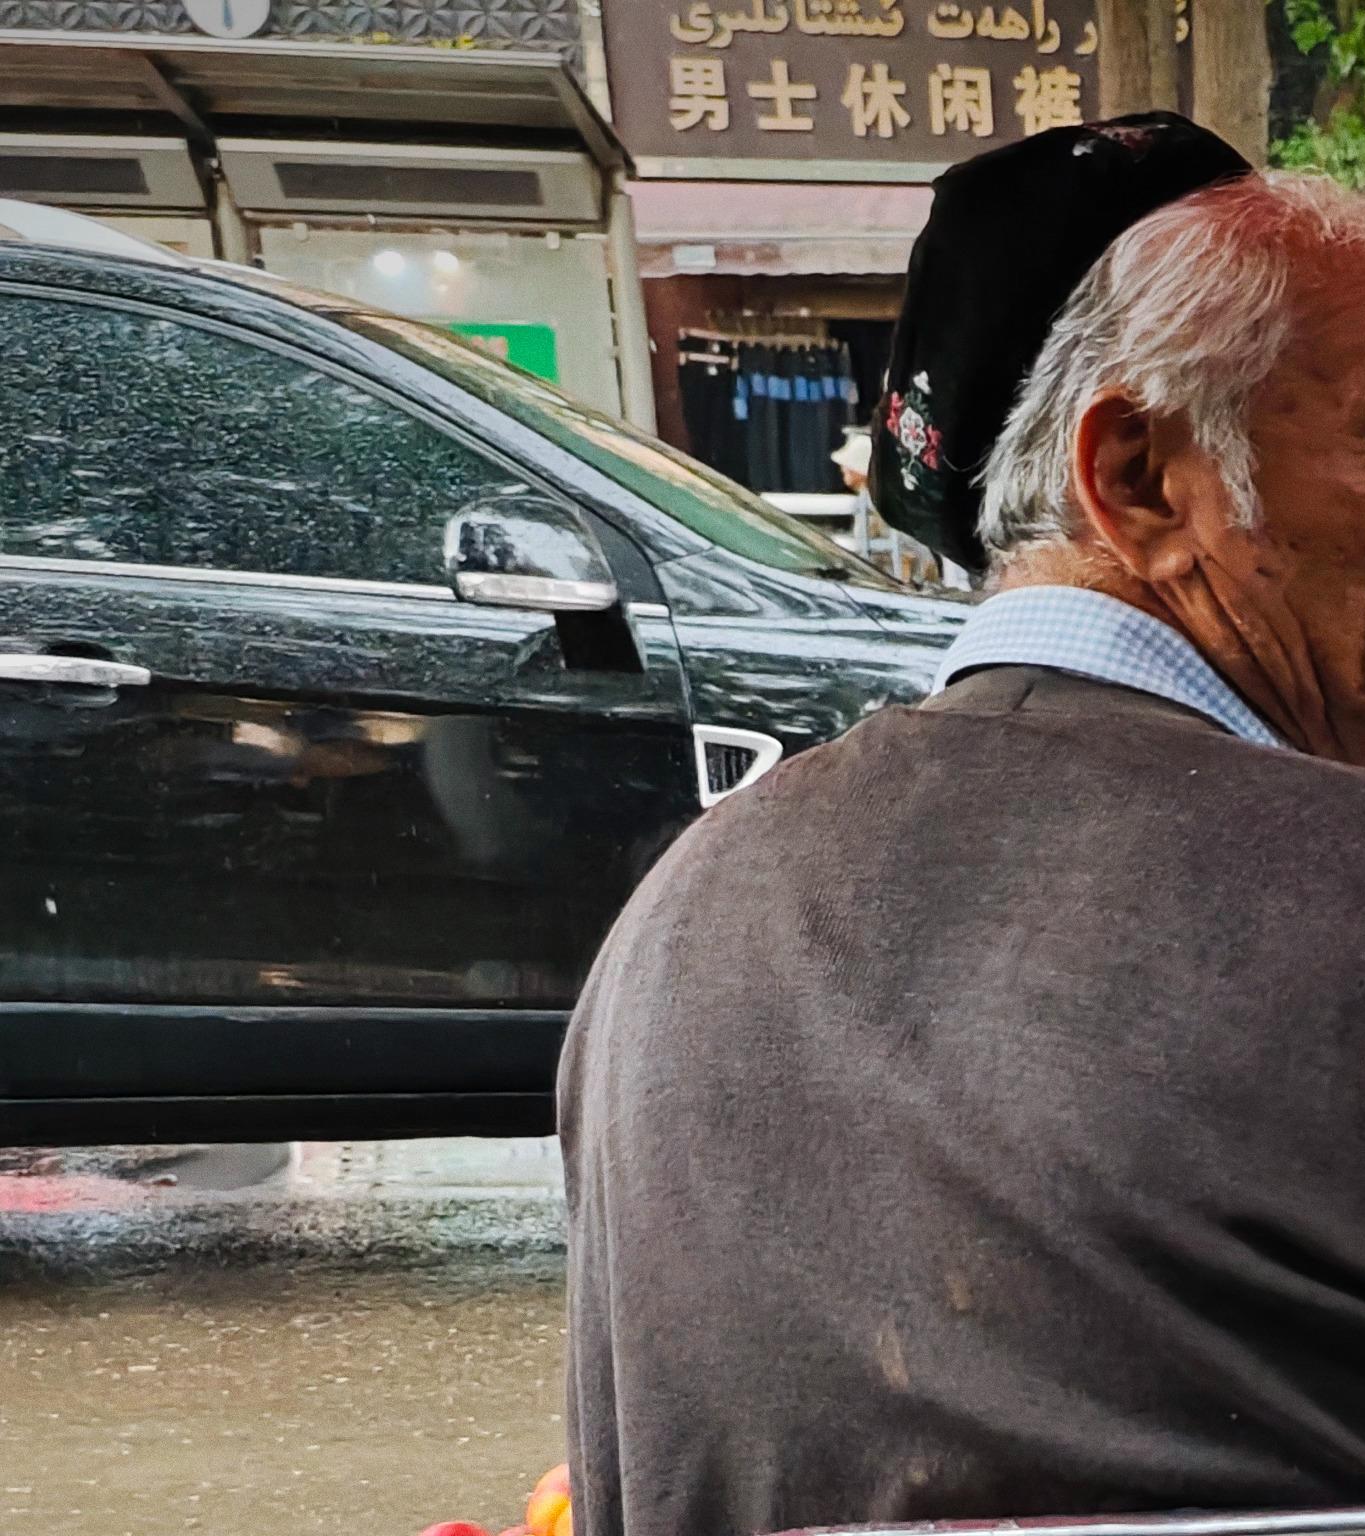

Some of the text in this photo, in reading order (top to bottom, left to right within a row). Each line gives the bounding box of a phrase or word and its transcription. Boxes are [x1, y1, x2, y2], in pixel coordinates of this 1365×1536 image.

[669, 57, 1086, 137] 男士休闲裤
